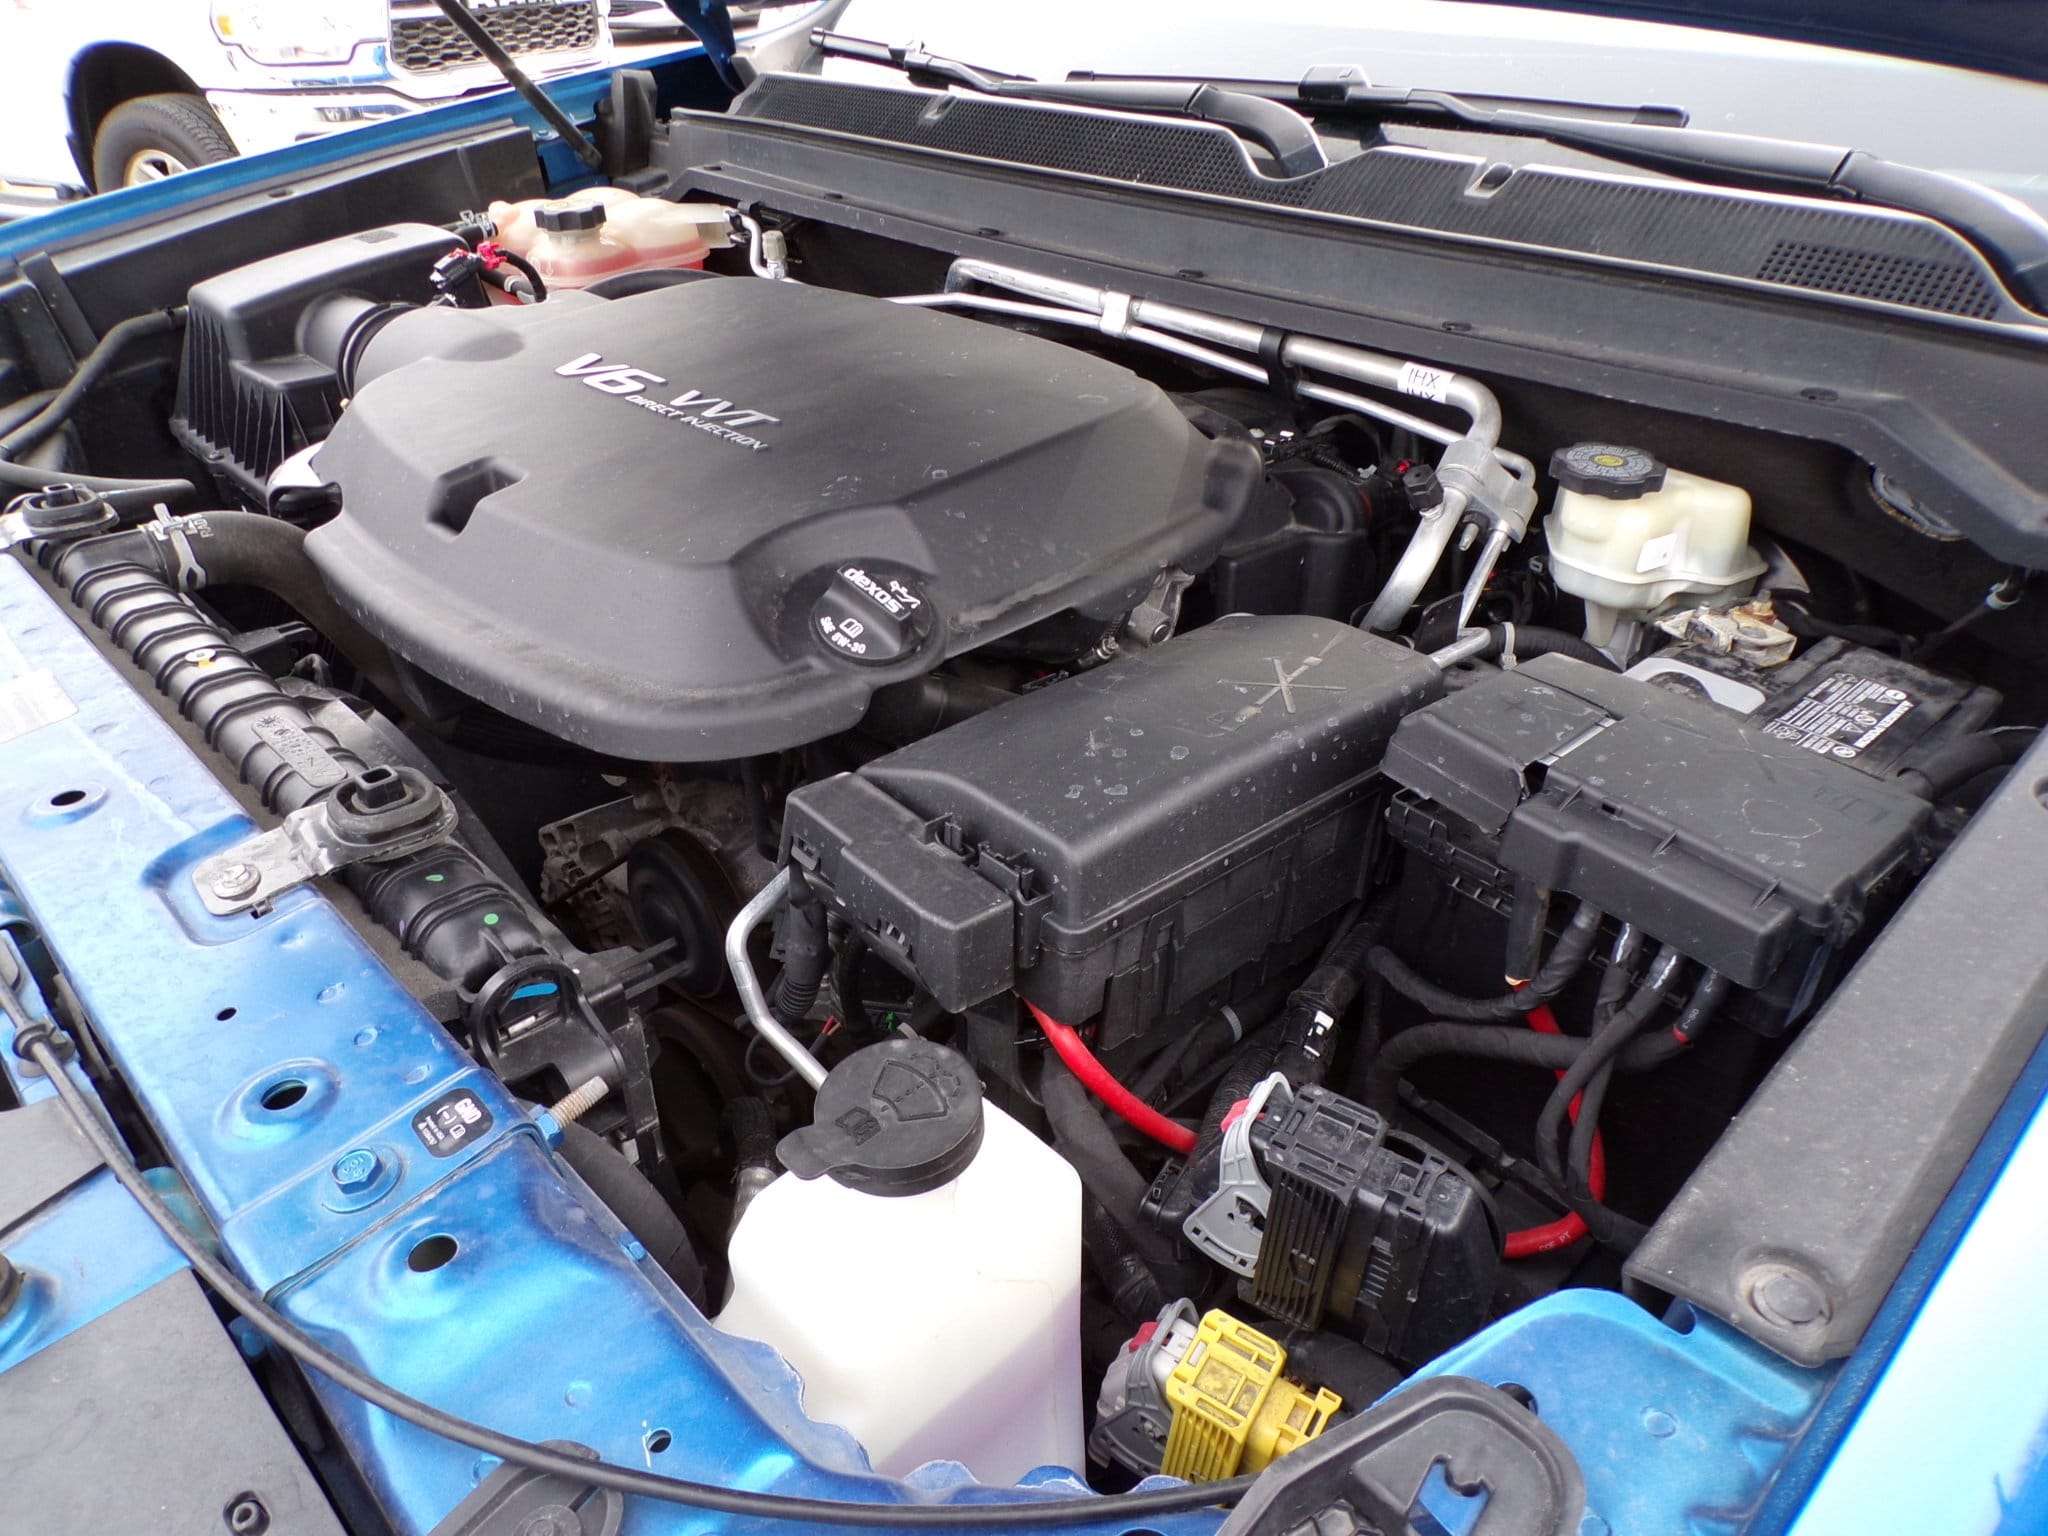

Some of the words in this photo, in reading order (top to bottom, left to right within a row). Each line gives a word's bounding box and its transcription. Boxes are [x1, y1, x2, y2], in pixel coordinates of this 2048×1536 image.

[555, 352, 667, 395] V6
[670, 389, 782, 427] VVT
[624, 395, 685, 419] DIRECT
[680, 415, 769, 451] INJECTION
[843, 567, 904, 613] dexos
[454, 1098, 482, 1124] GND
